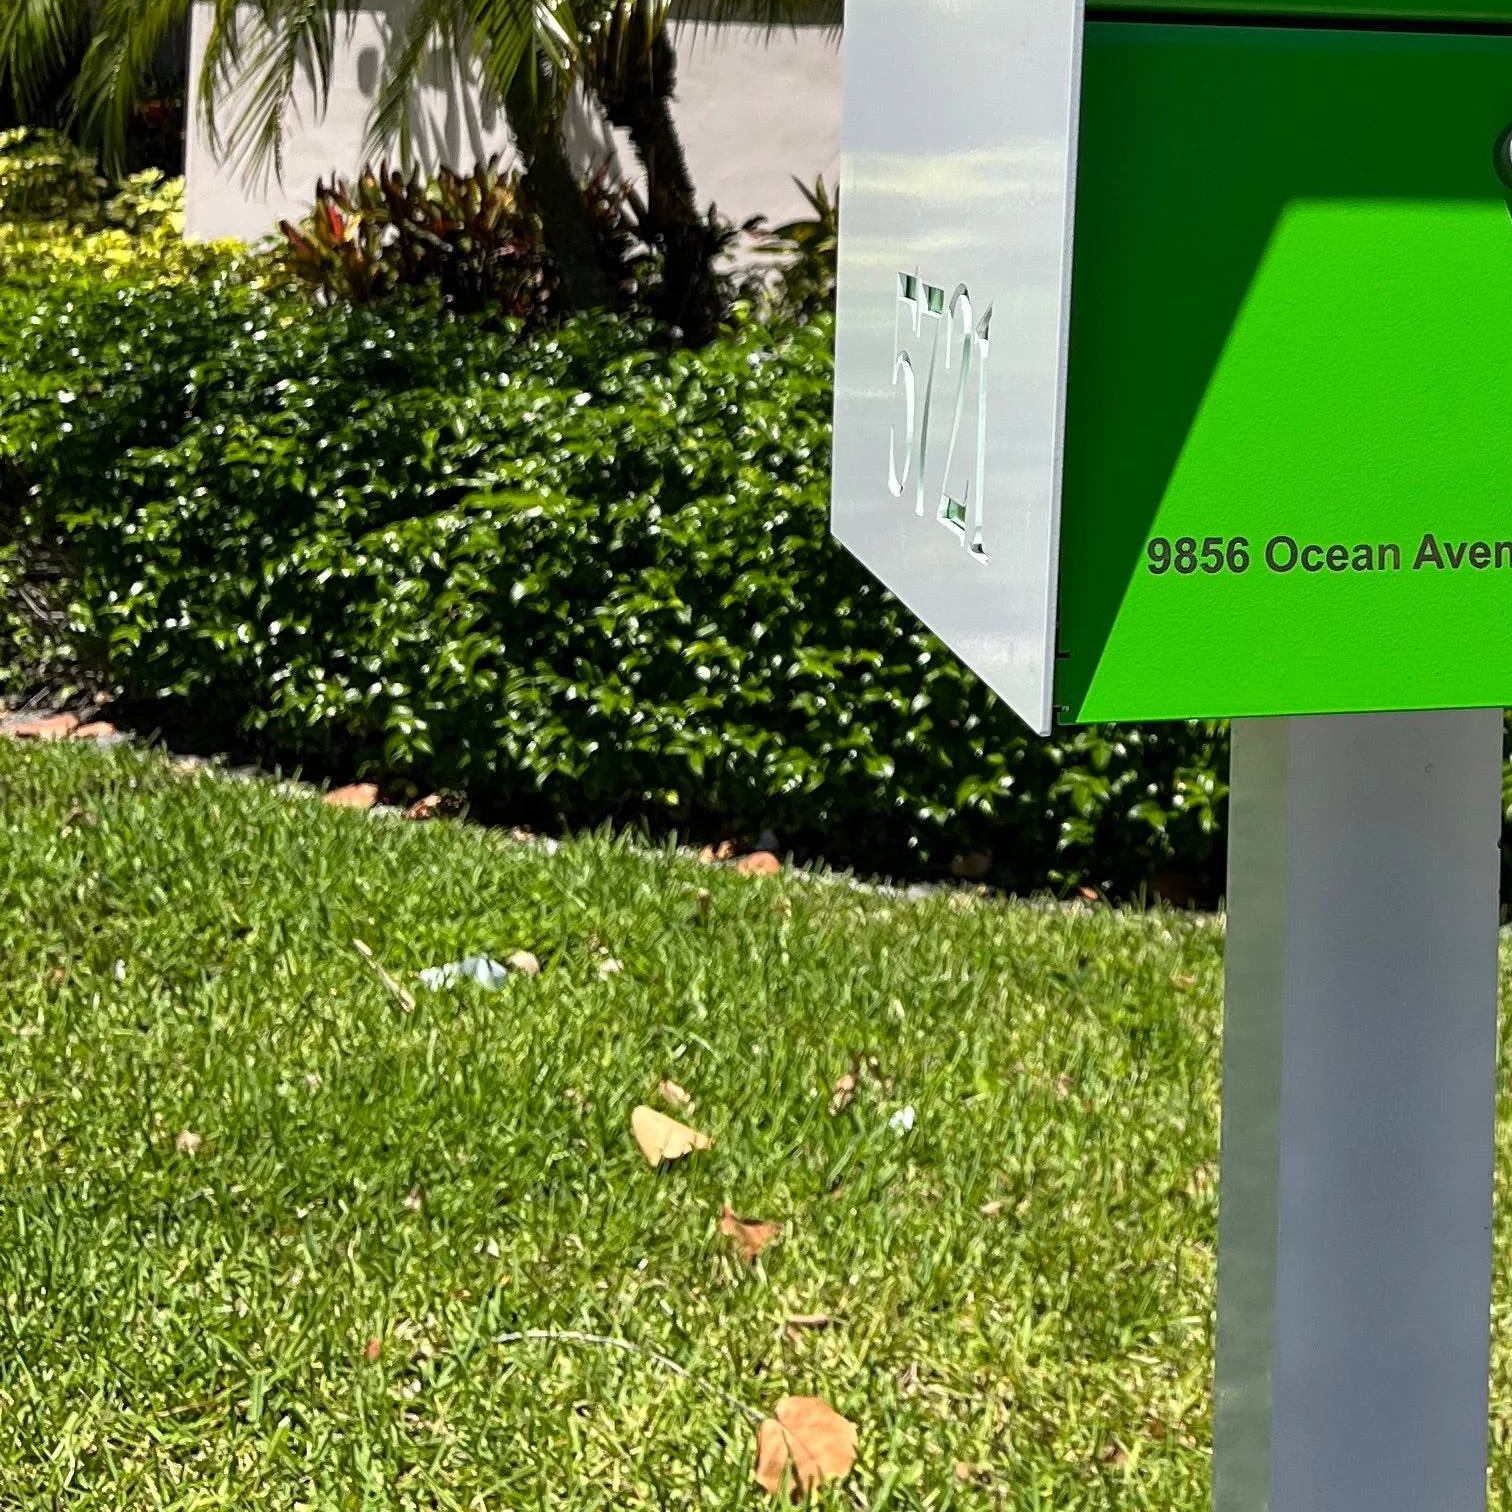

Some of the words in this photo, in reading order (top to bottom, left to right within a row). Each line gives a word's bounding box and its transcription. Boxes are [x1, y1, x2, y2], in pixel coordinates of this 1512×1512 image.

[887, 268, 994, 567] 5721
[1146, 536, 1250, 575] 9856
[1265, 535, 1401, 573] Ocean
